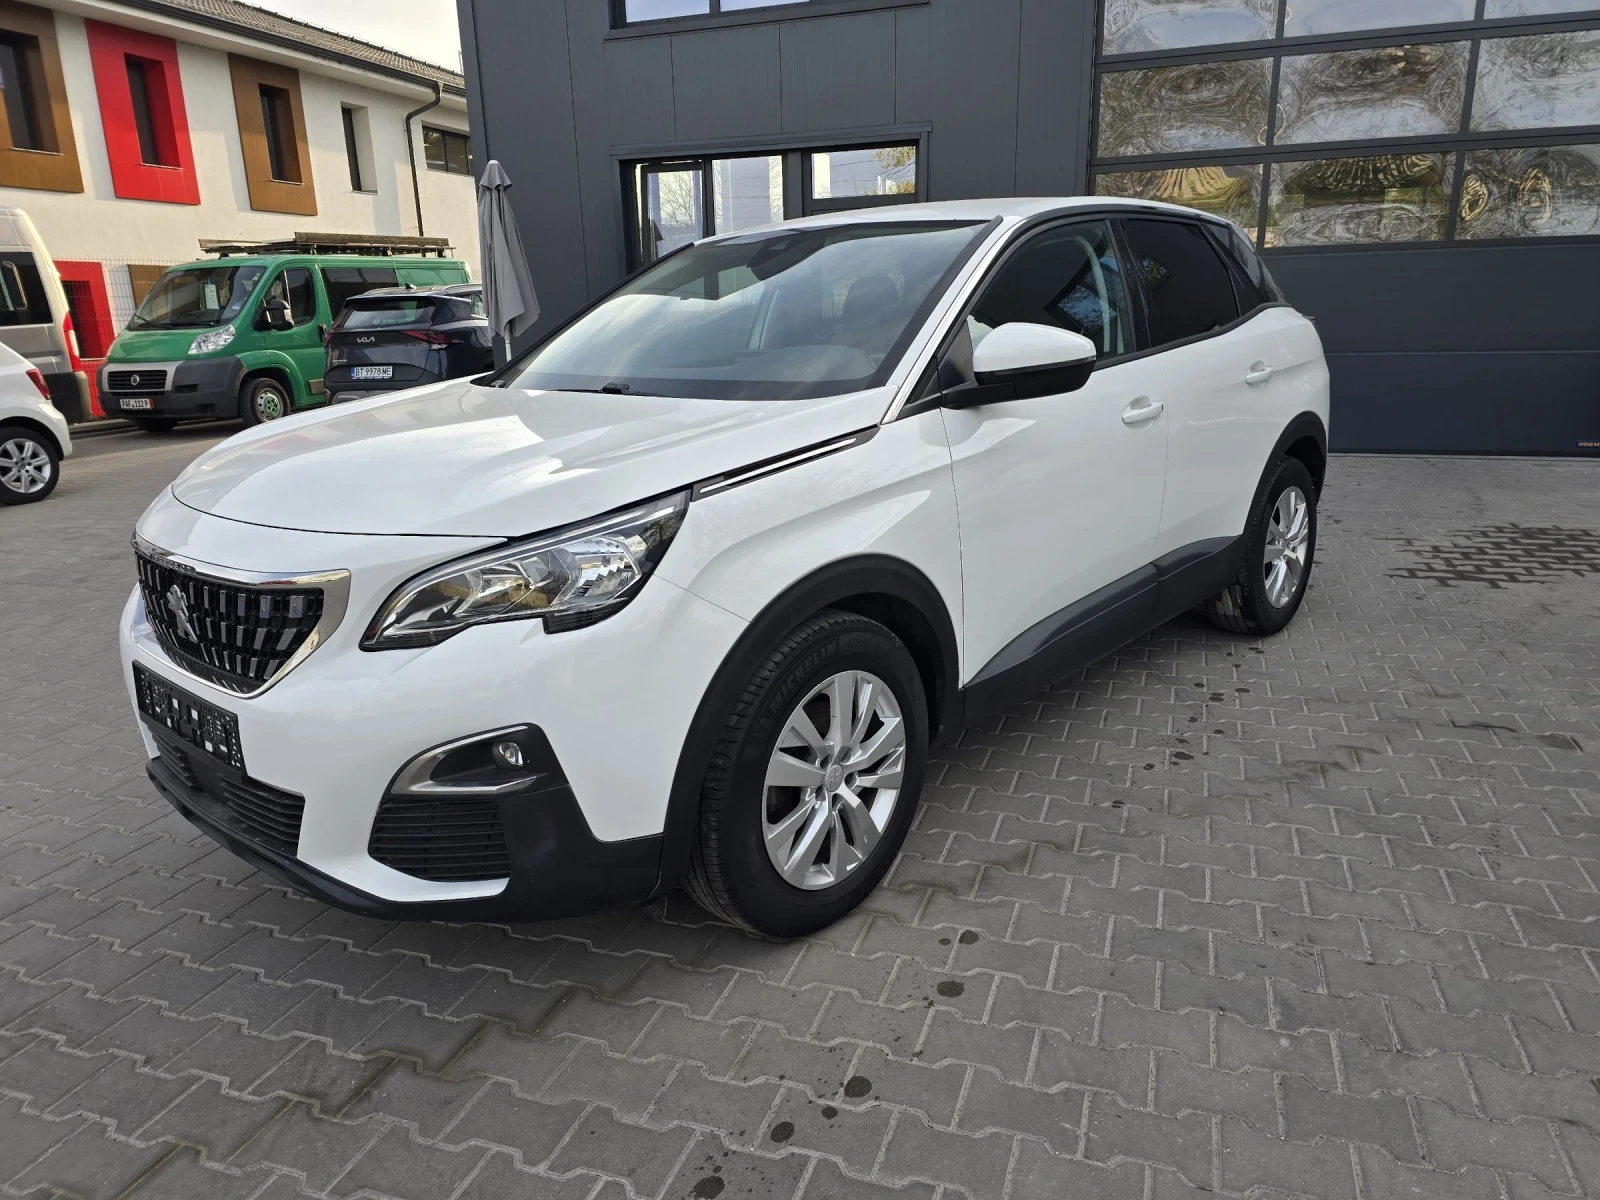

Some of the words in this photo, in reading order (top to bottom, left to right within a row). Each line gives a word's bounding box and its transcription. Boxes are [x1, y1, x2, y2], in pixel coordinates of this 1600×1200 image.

[355, 367, 364, 376] BT
[365, 367, 381, 376] 9978
[382, 367, 391, 376] ME
[769, 641, 837, 715] MICHELIN
